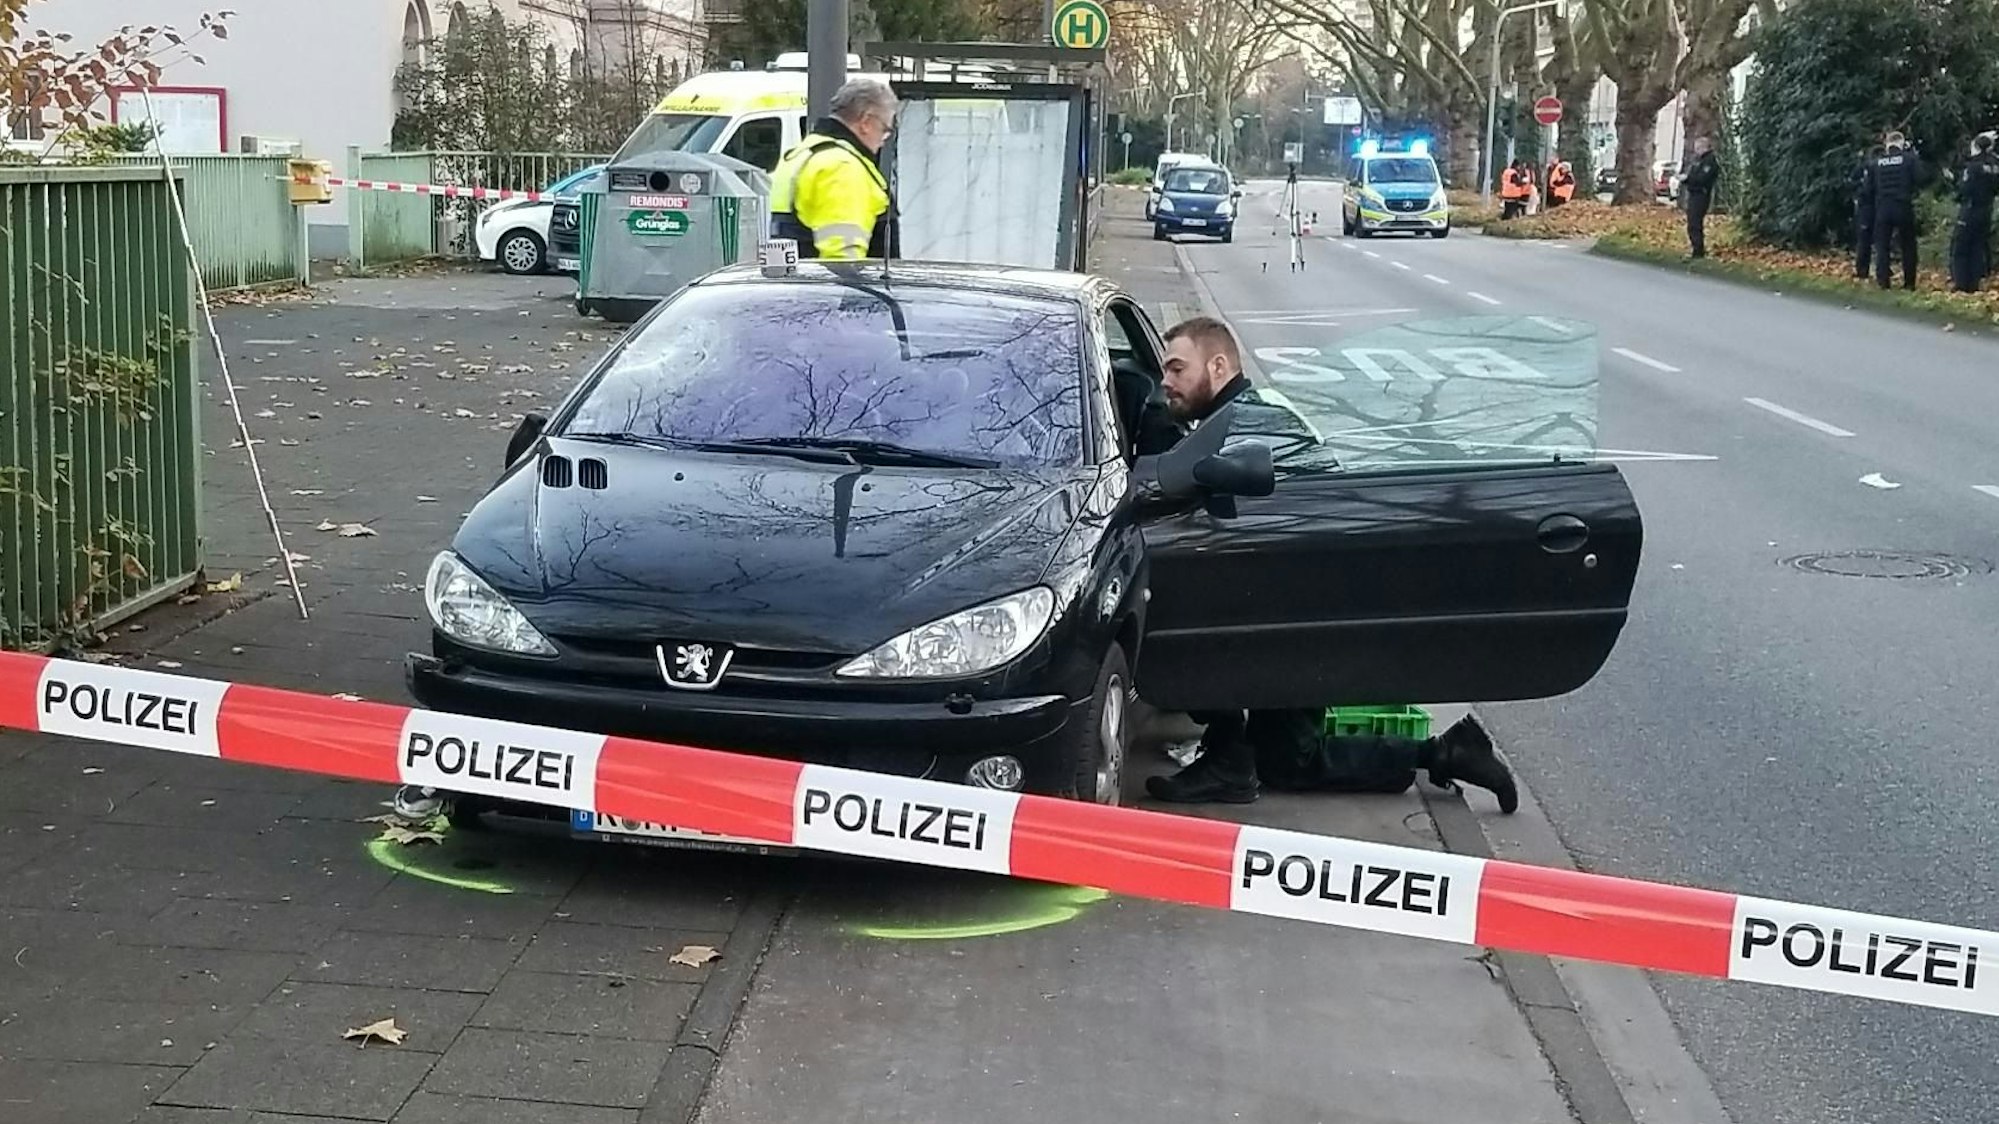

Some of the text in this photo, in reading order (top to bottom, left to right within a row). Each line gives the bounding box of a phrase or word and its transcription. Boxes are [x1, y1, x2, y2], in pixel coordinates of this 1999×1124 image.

[1069, 14, 1093, 44] H
[630, 196, 683, 207] REMONDIS
[44, 680, 198, 735] POLIZEI
[406, 732, 574, 791] POLIZEI
[802, 789, 986, 851] POLIZEI
[1242, 849, 1450, 916] POLIZEI
[1741, 917, 1978, 989] POLIZEI
